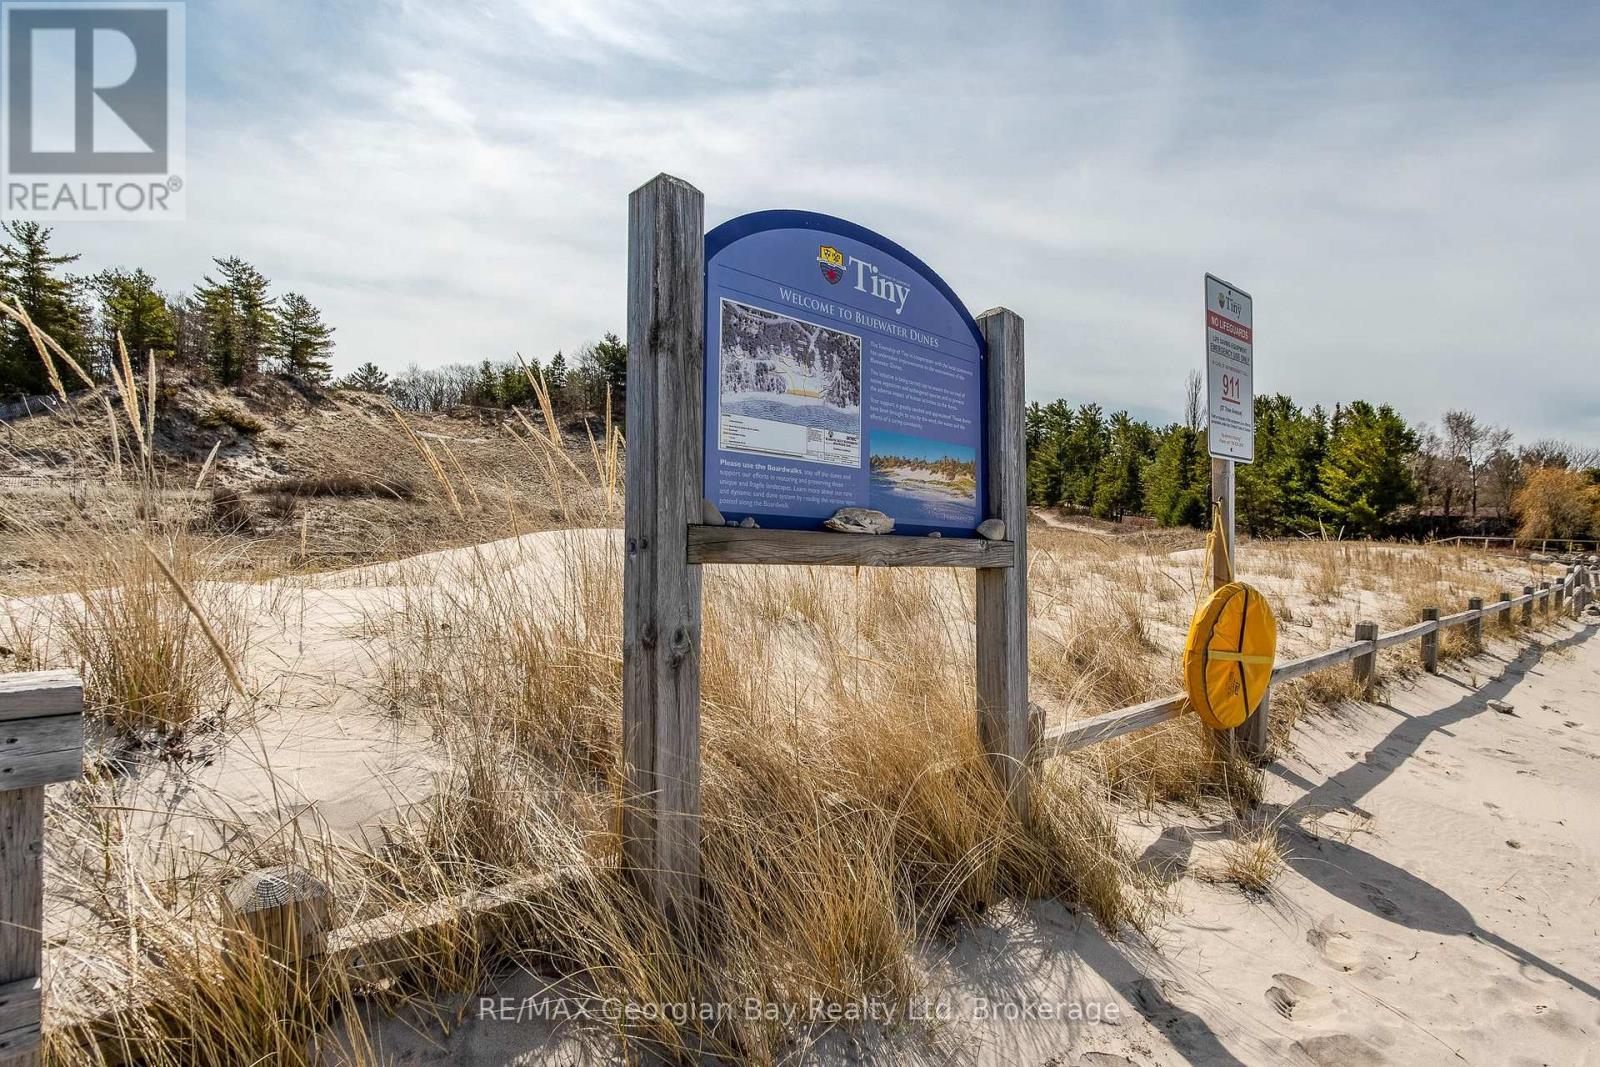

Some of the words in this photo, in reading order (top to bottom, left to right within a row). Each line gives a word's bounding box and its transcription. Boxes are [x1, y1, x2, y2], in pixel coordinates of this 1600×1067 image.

[849, 255, 911, 314] Tiny
[1225, 295, 1242, 319] Tiny
[1210, 315, 1219, 328] NO
[1219, 319, 1249, 340] LIFEGUARDS
[1222, 374, 1240, 399] 911
[720, 459, 741, 468] Please
[755, 463, 766, 471] the
[767, 464, 802, 475] Boardwalks,
